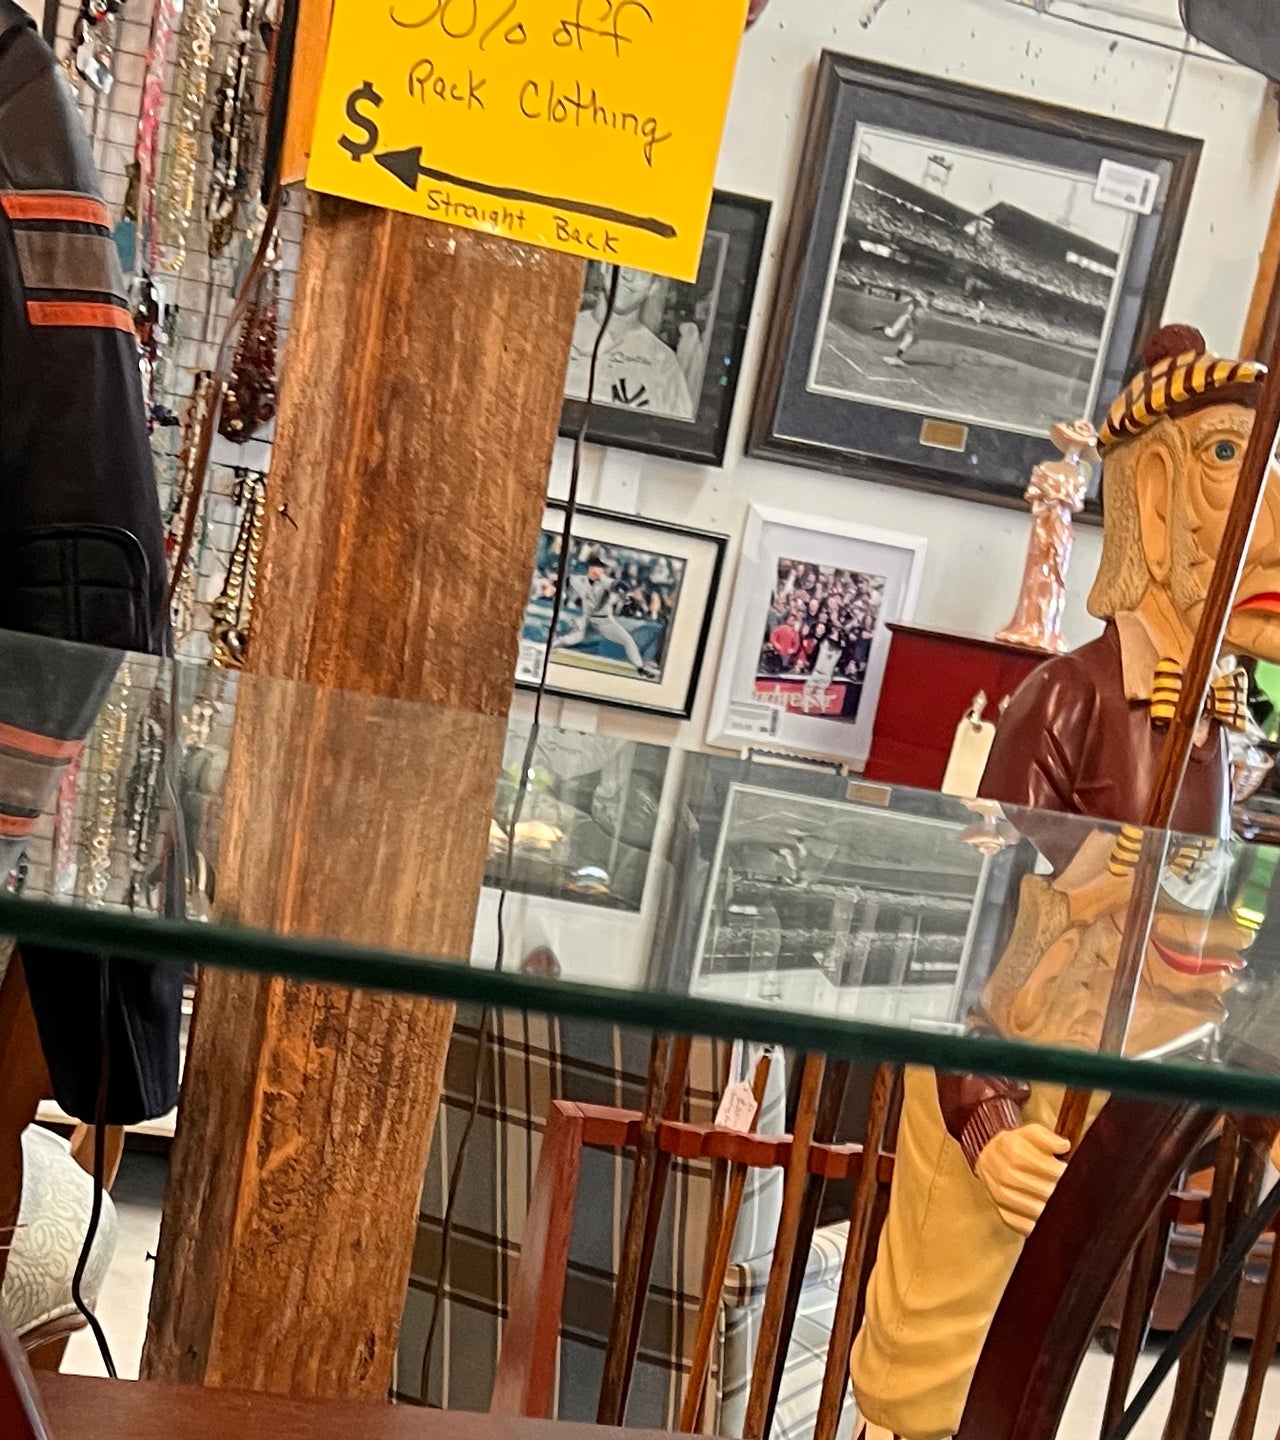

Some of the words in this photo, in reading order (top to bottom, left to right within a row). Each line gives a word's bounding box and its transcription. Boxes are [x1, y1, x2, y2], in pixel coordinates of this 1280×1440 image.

[408, 58, 487, 109] Rack
[519, 79, 672, 167] Clothing
[426, 189, 527, 230] Straight
[554, 217, 619, 254] Back
